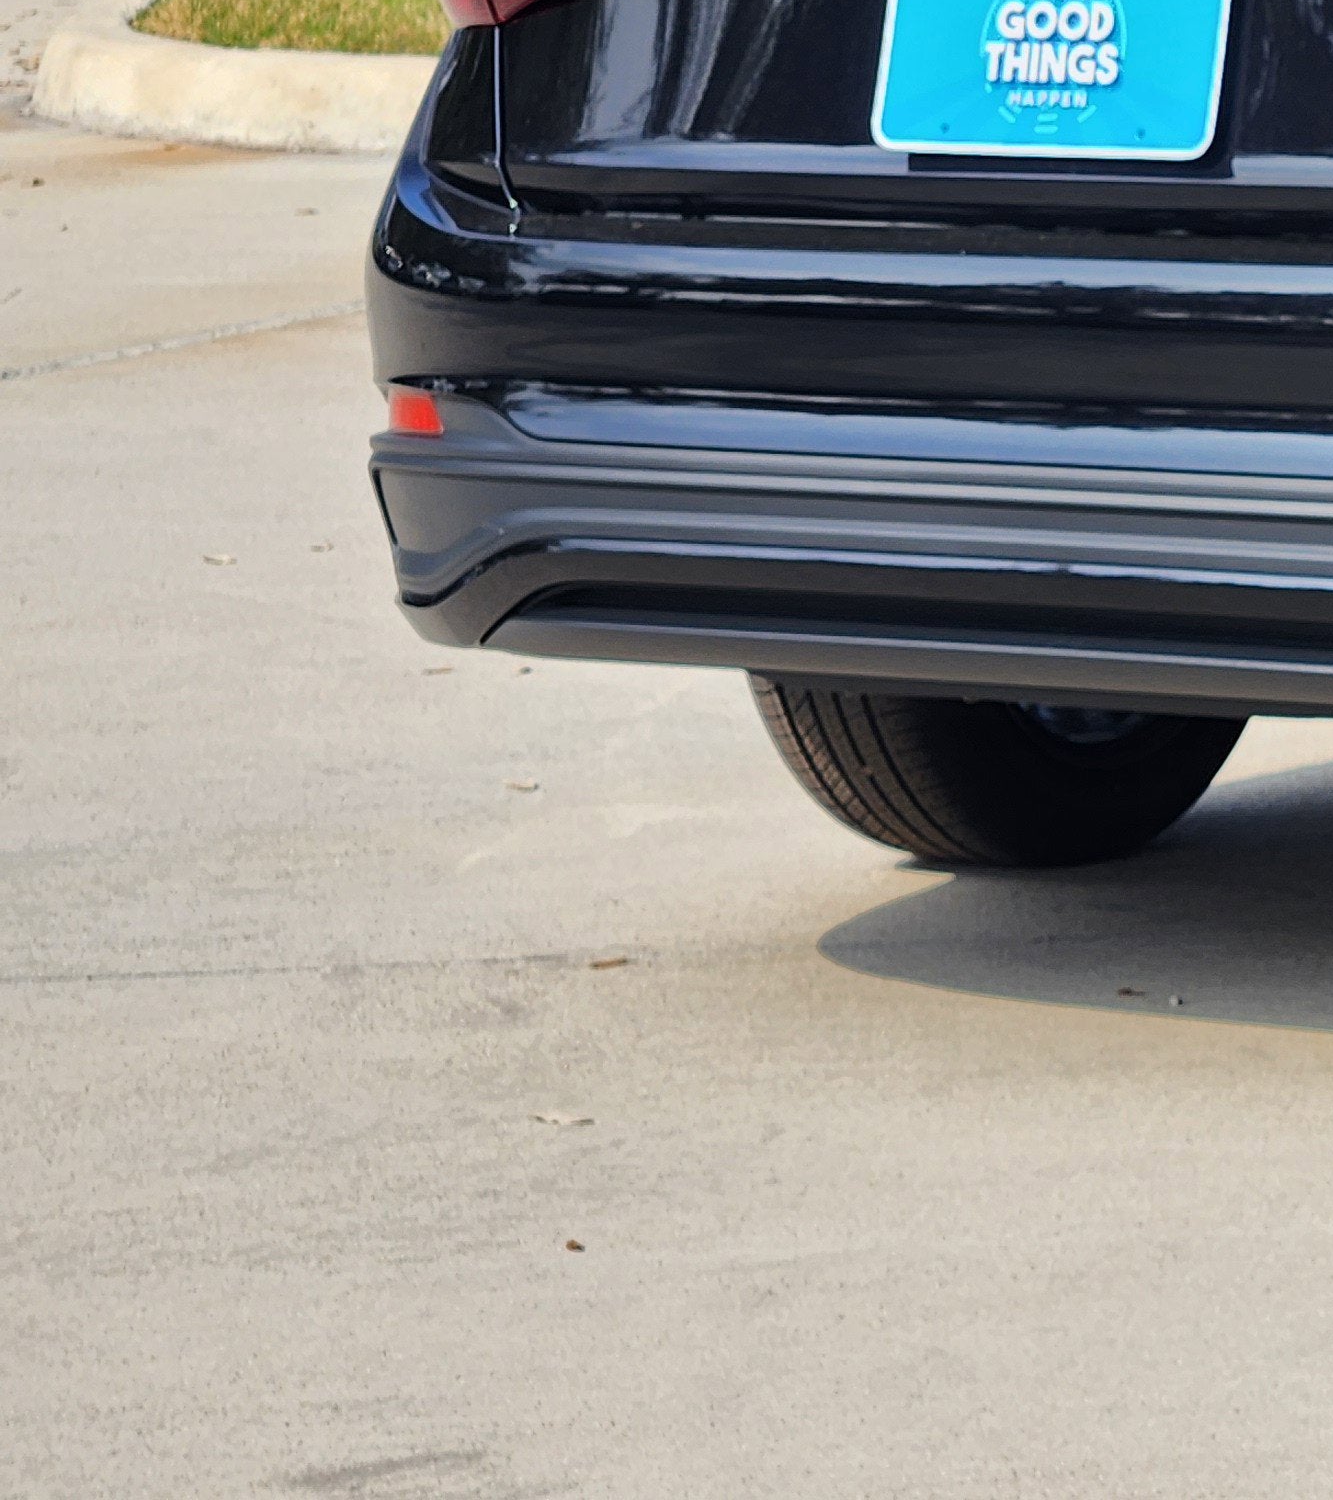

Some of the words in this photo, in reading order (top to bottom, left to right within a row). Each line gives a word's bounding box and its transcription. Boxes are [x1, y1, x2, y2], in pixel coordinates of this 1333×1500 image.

[996, 0, 1114, 42] GOOD
[985, 42, 1119, 86] THINGS
[1007, 89, 1088, 108] HAPPEN
